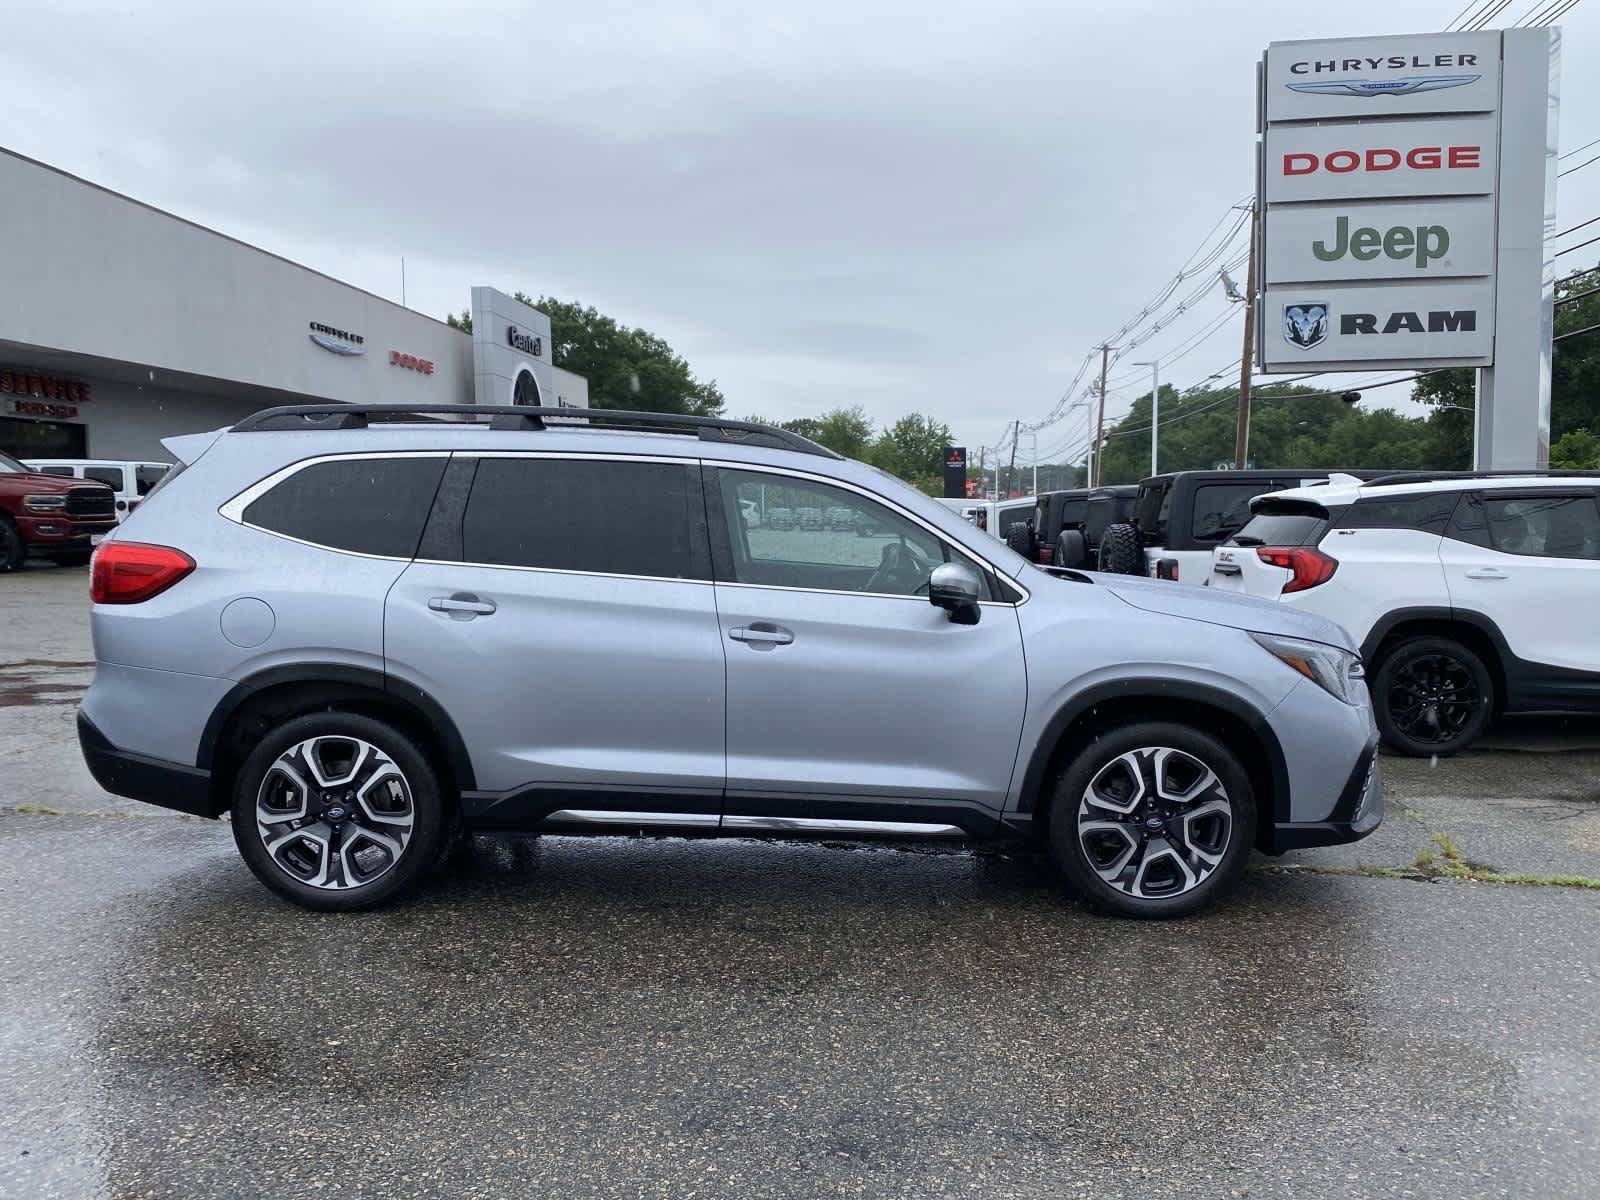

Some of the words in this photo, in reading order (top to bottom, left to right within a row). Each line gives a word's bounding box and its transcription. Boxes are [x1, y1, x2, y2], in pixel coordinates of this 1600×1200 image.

[1290, 54, 1478, 75] CHRYSLER
[1283, 146, 1481, 176] DODGE
[1312, 215, 1450, 268] Jeep
[309, 321, 364, 344] CHRYSLER
[1340, 310, 1477, 335] RAM
[0, 371, 91, 402] SERVICE
